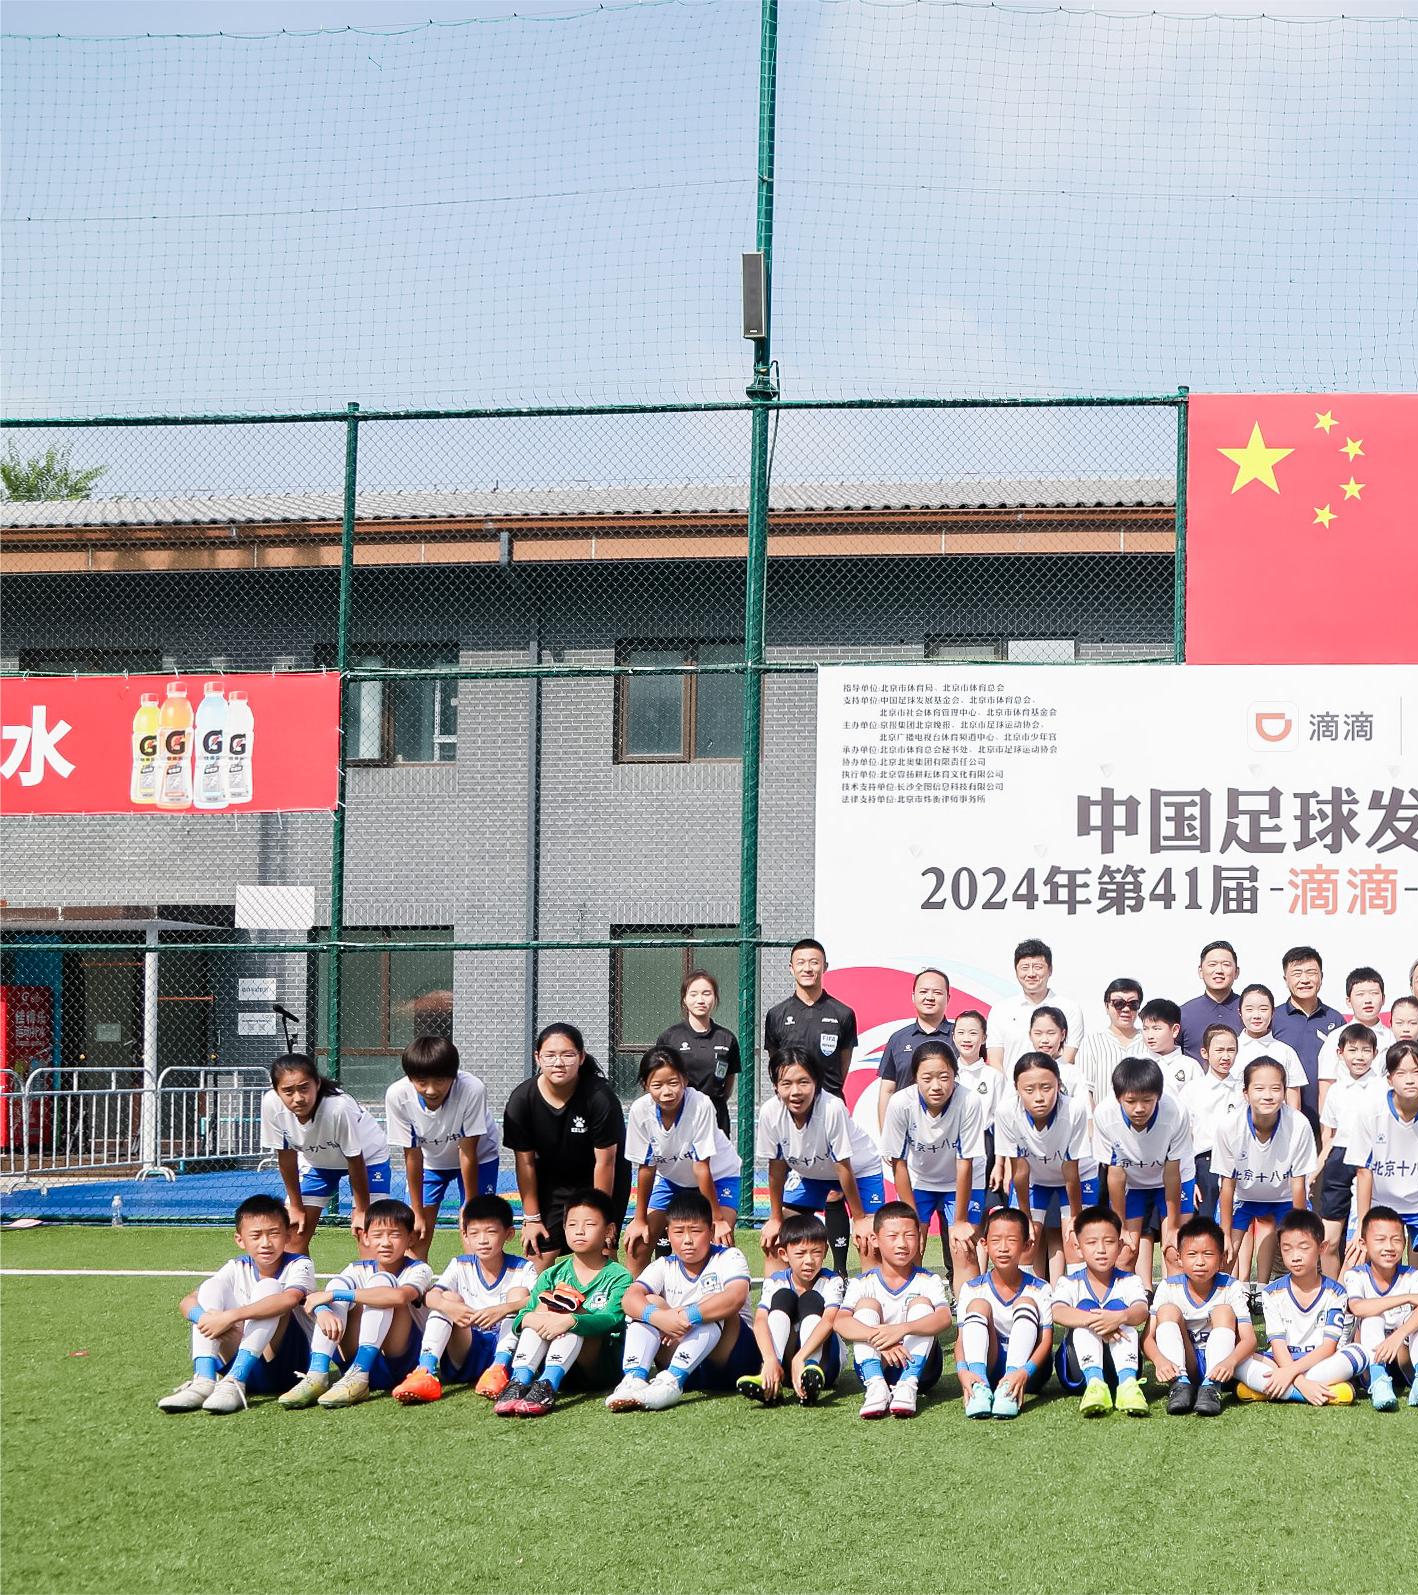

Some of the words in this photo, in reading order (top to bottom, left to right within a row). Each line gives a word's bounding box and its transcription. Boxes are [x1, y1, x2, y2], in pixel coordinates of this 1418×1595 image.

[1309, 711, 1374, 742] 滴滴
[0, 705, 76, 787] 水
[139, 735, 157, 757] G
[165, 731, 186, 755] G
[203, 731, 223, 755] G
[229, 734, 247, 756] G
